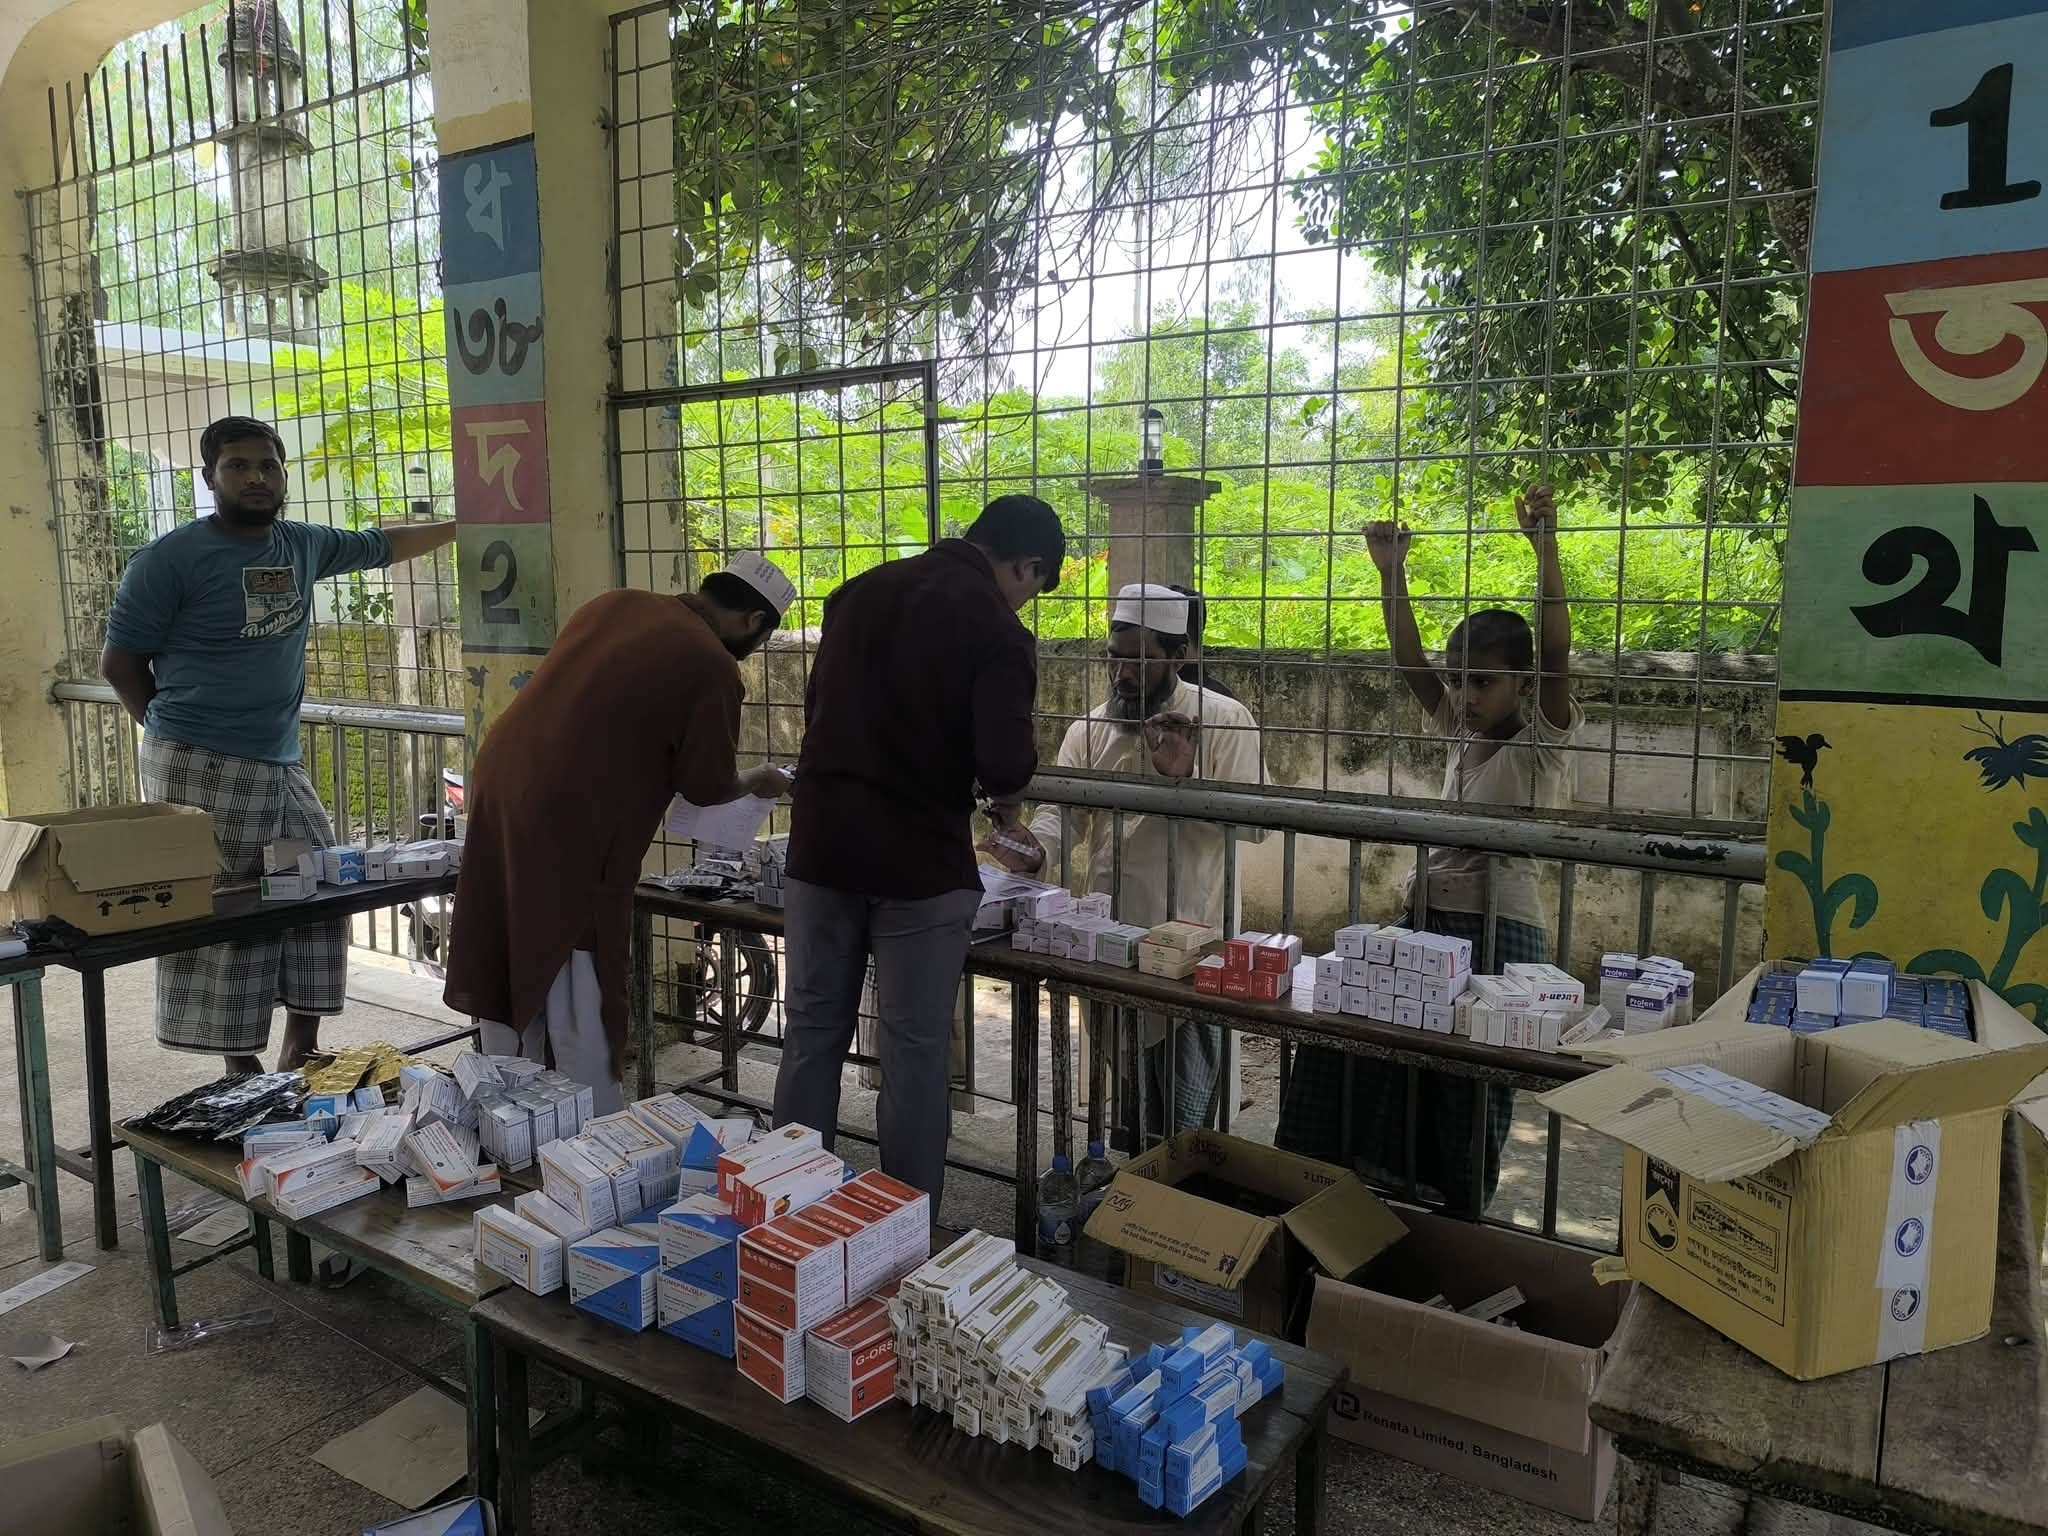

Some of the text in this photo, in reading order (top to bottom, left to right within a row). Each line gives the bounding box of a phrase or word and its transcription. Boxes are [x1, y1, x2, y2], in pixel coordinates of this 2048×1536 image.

[1929, 62, 2041, 211] 1
[480, 540, 521, 625] 2
[1604, 968, 1628, 978] Profen
[1538, 992, 1579, 1004] Lucan-R
[1629, 998, 1654, 1008] Profen
[855, 1339, 894, 1367] G-ORS
[1362, 1409, 1560, 1483] Renata Limited, Bangladesh
